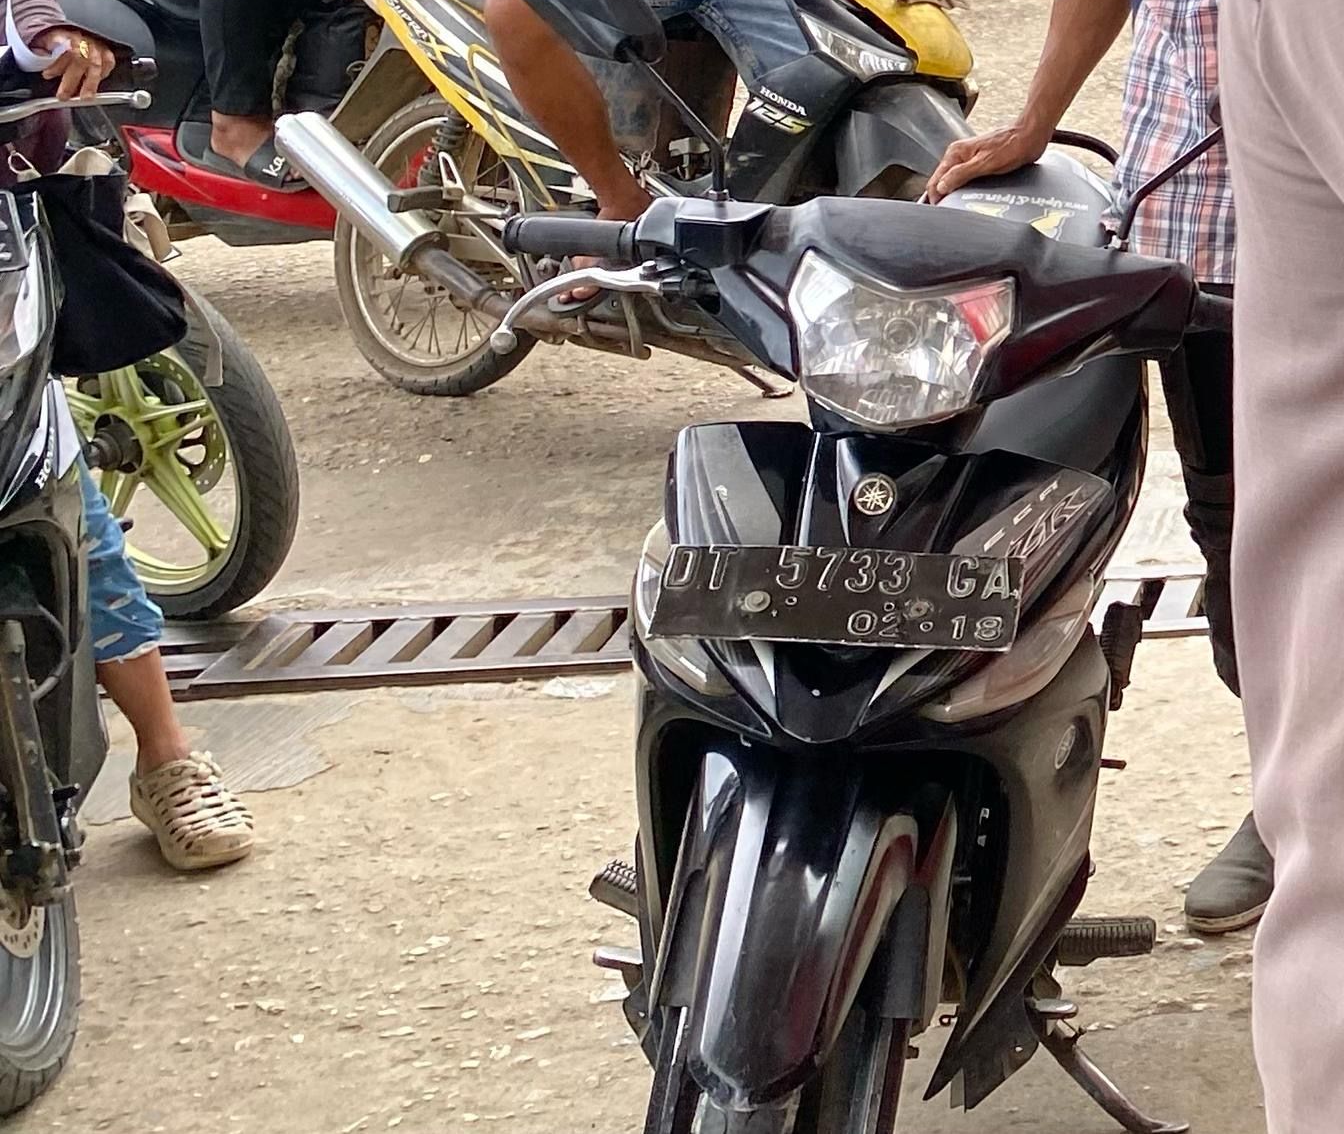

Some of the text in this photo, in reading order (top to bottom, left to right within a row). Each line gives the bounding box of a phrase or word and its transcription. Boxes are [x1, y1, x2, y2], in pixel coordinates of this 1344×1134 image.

[746, 96, 815, 135] 125
[759, 85, 808, 117] HONDA
[663, 544, 1011, 601] DT 5733 GA
[950, 614, 1004, 643] 18
